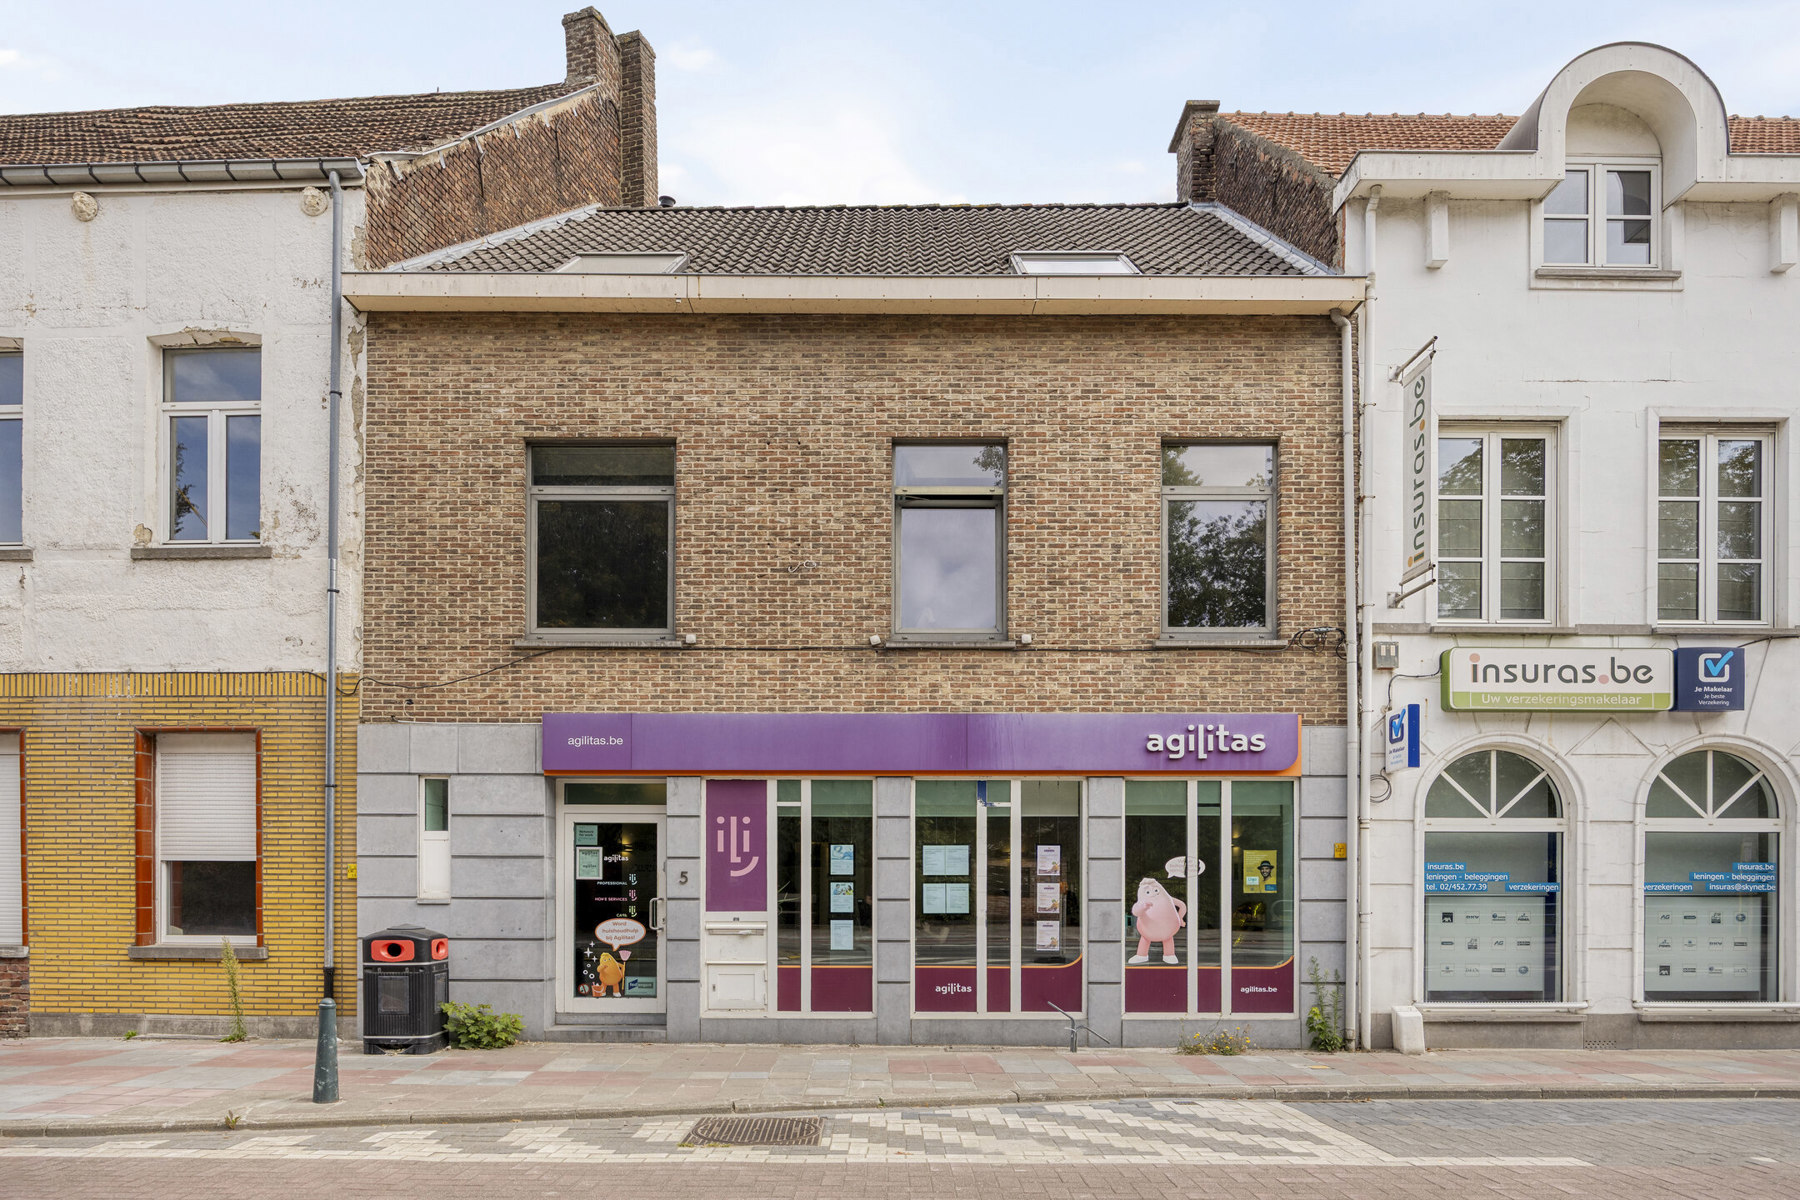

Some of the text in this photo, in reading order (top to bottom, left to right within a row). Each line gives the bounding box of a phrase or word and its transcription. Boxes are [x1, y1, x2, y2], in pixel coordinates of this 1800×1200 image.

[1407, 375, 1426, 568] insuras.be
[1469, 653, 1654, 684] insuras.be
[1481, 693, 1642, 707] Uw verzekeringsmakelaar
[567, 735, 624, 748] agilitas.be
[1146, 724, 1266, 759] agilitas
[603, 854, 629, 863] agilitas
[679, 871, 688, 885] 5
[1426, 873, 1457, 881] leningen
[1464, 873, 1508, 881] beleggingen
[1693, 873, 1724, 881] leningen
[1731, 873, 1775, 881] beleggingen
[1426, 883, 1487, 891] tel. 02/452.77.39
[1508, 883, 1559, 891] verzekeringen
[1644, 883, 1693, 891] verzekeringen
[1709, 883, 1776, 891] insuras@skynet.be
[935, 983, 972, 994] agilitas
[1240, 986, 1278, 994] agilitas.be
